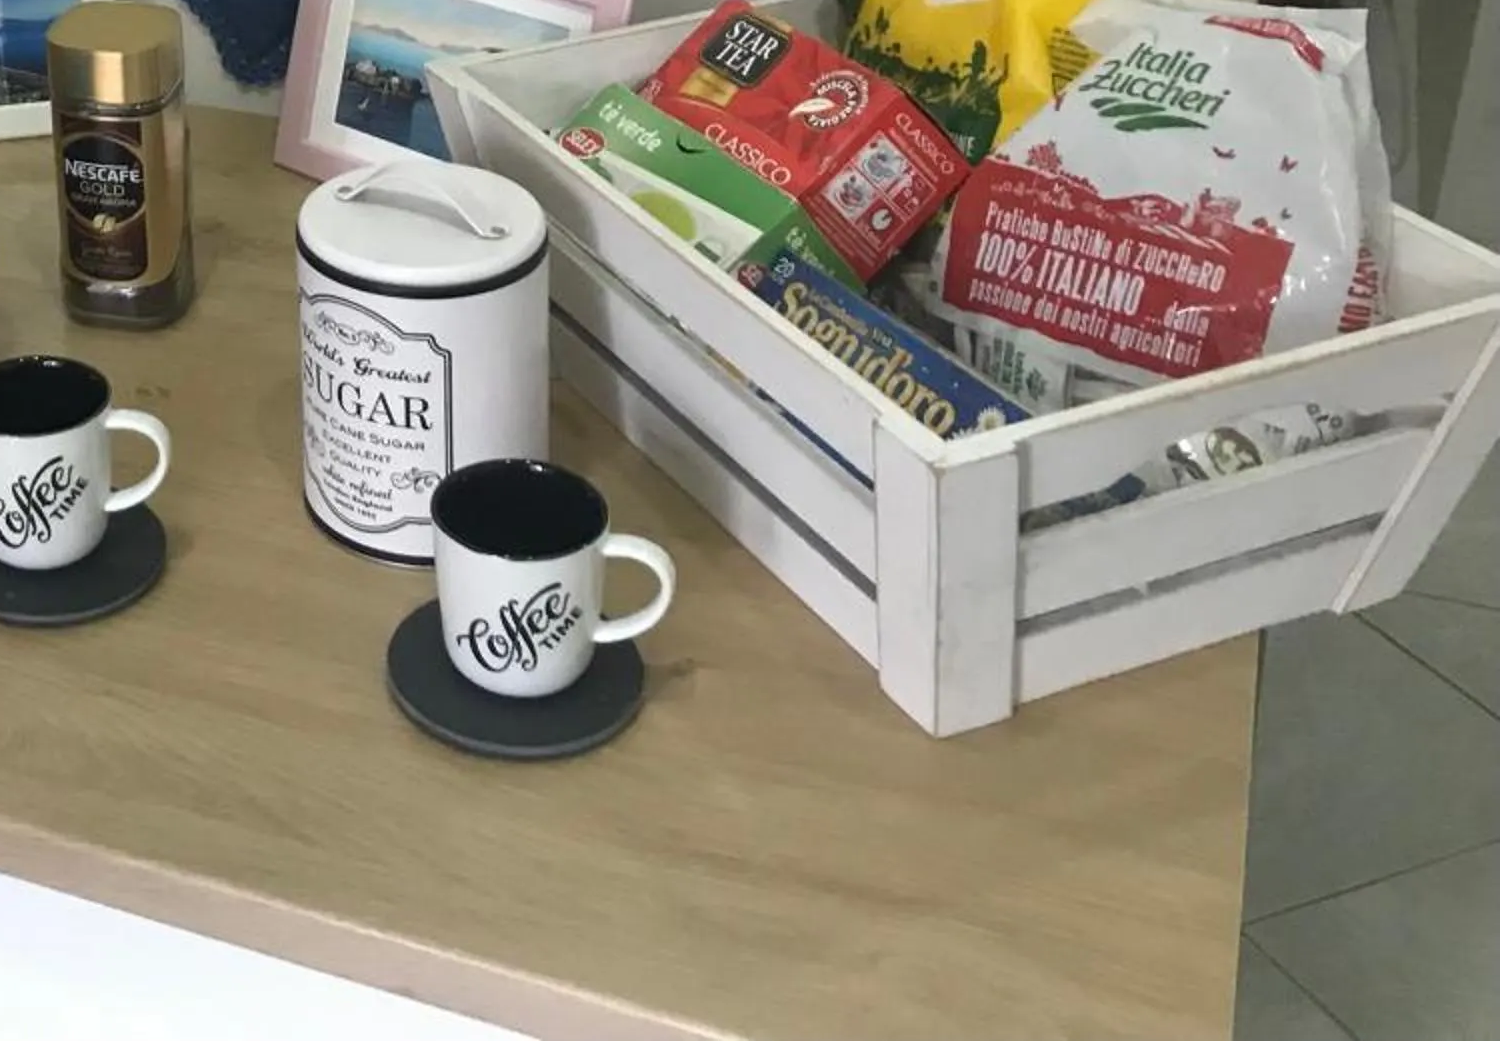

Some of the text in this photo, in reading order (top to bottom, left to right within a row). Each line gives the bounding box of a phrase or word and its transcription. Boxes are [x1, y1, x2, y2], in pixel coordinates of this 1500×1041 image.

[716, 40, 756, 76] TEA
[725, 20, 779, 60] STAR
[1125, 42, 1212, 84] Italia
[1078, 59, 1231, 117] Zuccheri
[616, 115, 662, 152] verde
[705, 123, 791, 185] CLASSICO
[80, 180, 125, 197] GOLD
[986, 200, 1049, 243] Pratiche
[1114, 238, 1135, 266] di
[974, 230, 1145, 316] 100% ITALIANO
[968, 278, 1033, 315] passione
[1033, 293, 1062, 323] dei
[1060, 307, 1111, 339] nostri
[303, 351, 433, 431] SUGAR
[353, 357, 431, 383] Greatest
[369, 433, 425, 451] SUGAR
[49, 476, 89, 521] TIME
[456, 581, 571, 673] Coffee
[538, 605, 582, 651] TIME
